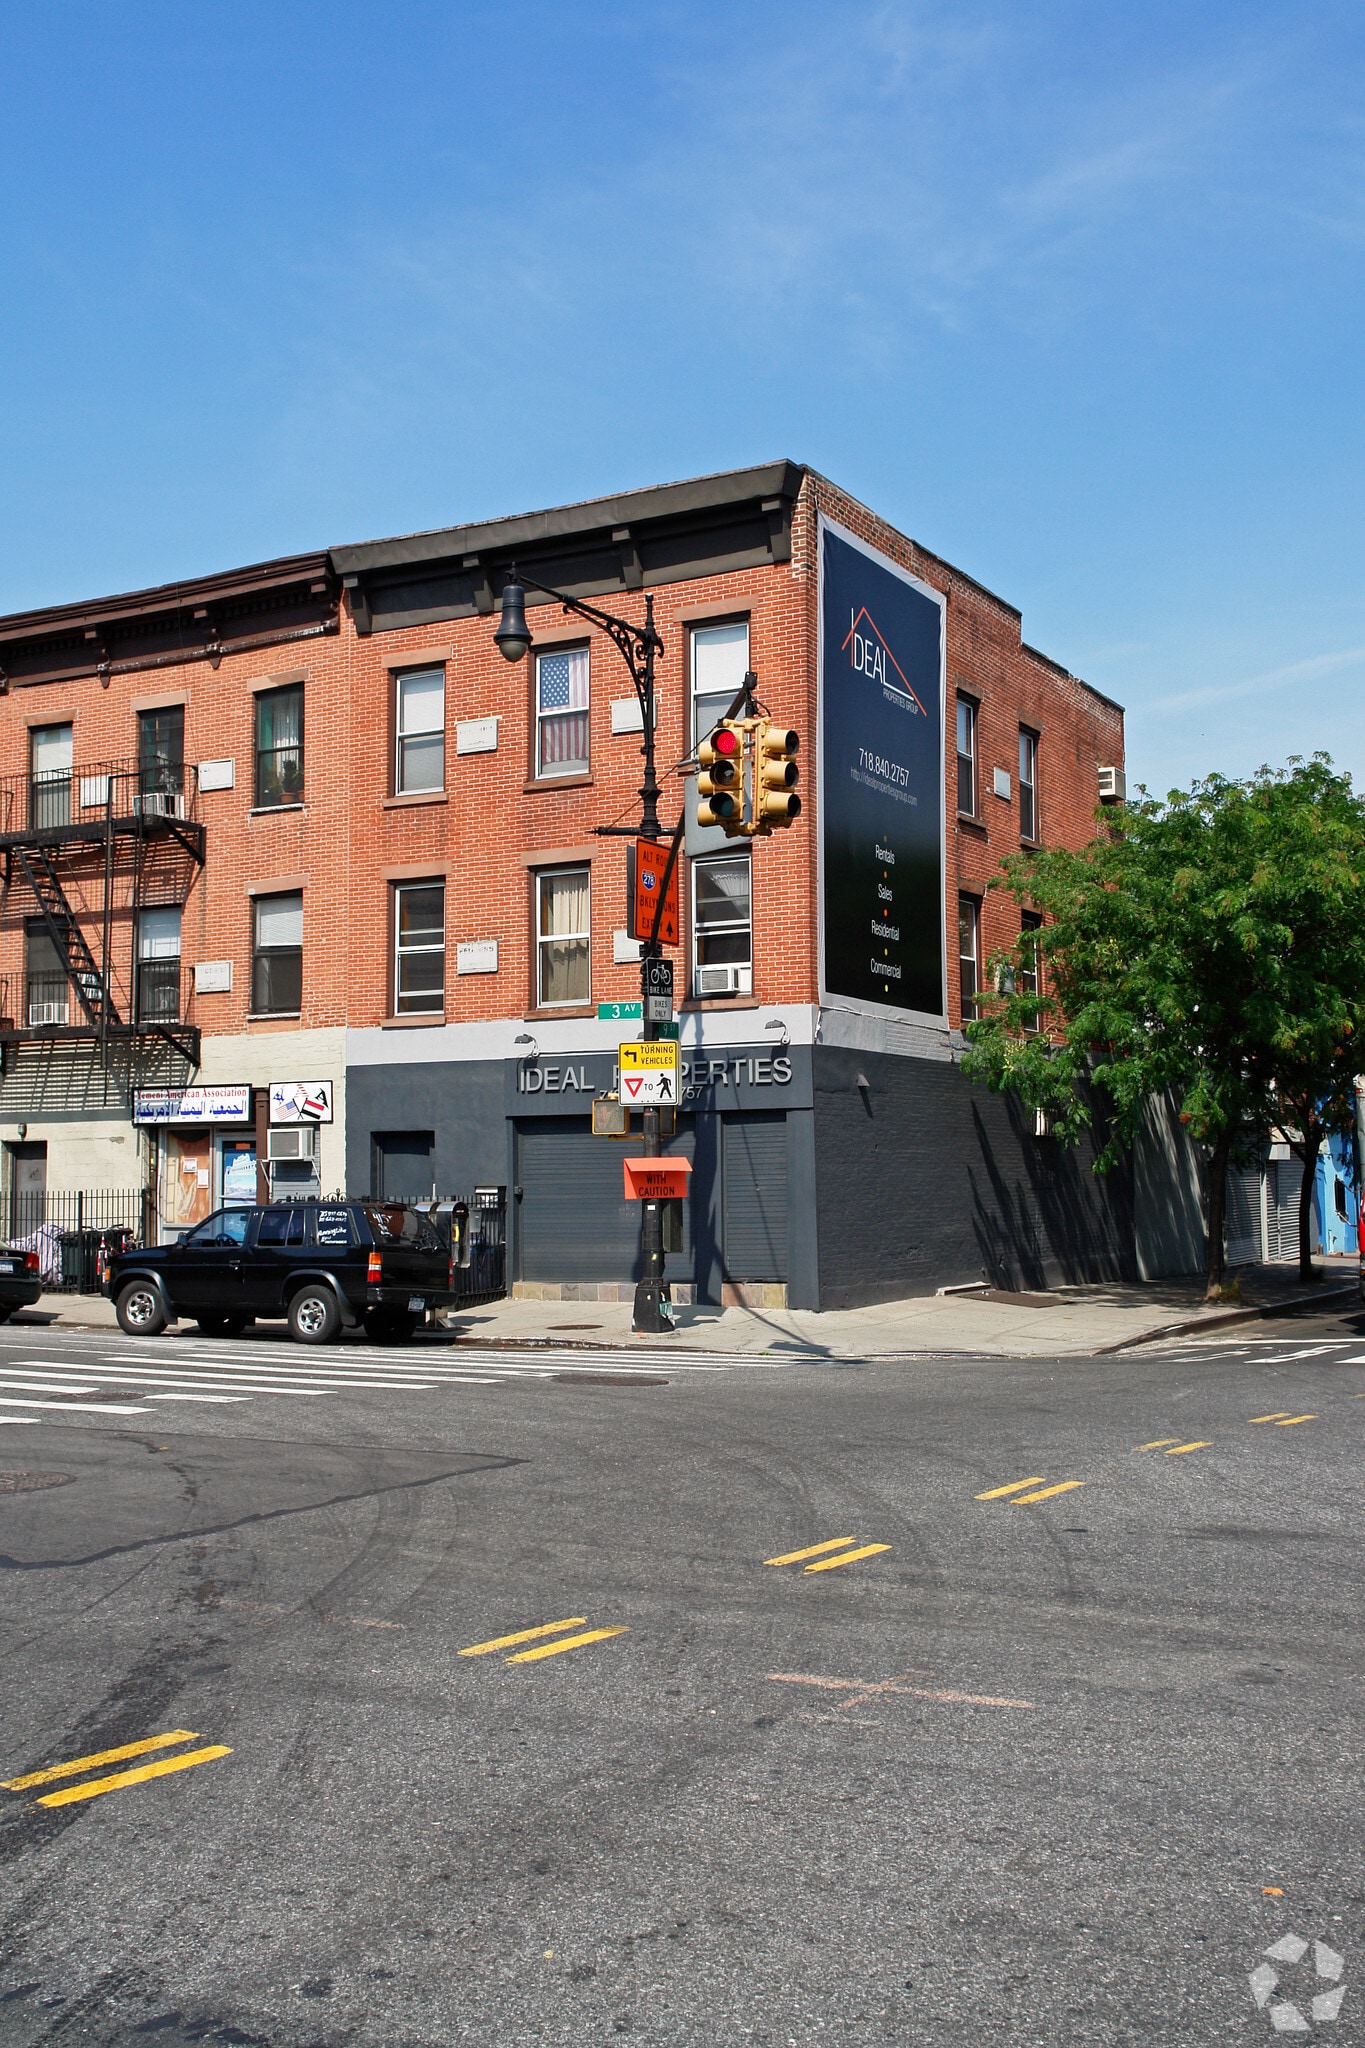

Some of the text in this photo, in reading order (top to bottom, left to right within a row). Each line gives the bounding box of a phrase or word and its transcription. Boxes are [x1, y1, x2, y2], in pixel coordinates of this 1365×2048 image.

[851, 607, 915, 701] IDEAL
[882, 687, 919, 715] PROPERTIES GROUP
[859, 747, 910, 787] 718.840.2757
[643, 850, 653, 863] ALT
[875, 844, 896, 865] Rentals
[643, 874, 654, 886] 278
[877, 883, 893, 901] Sales
[871, 919, 900, 941] Residential
[870, 958, 902, 979] Commercial
[649, 985, 672, 995] BIKE LANE
[654, 1000, 668, 1008] BIKES
[612, 1004, 636, 1019] 3 AV
[655, 1010, 667, 1018] ONLY
[663, 1023, 668, 1036] 9
[641, 1045, 674, 1055] TURNING
[641, 1057, 673, 1065] VEHICLES
[519, 1066, 596, 1093] IDEAL
[136, 1086, 247, 1100] Yemeni American Association
[644, 1083, 654, 1091] TO
[646, 1174, 667, 1185] WITH
[638, 1186, 675, 1197] CAUTION
